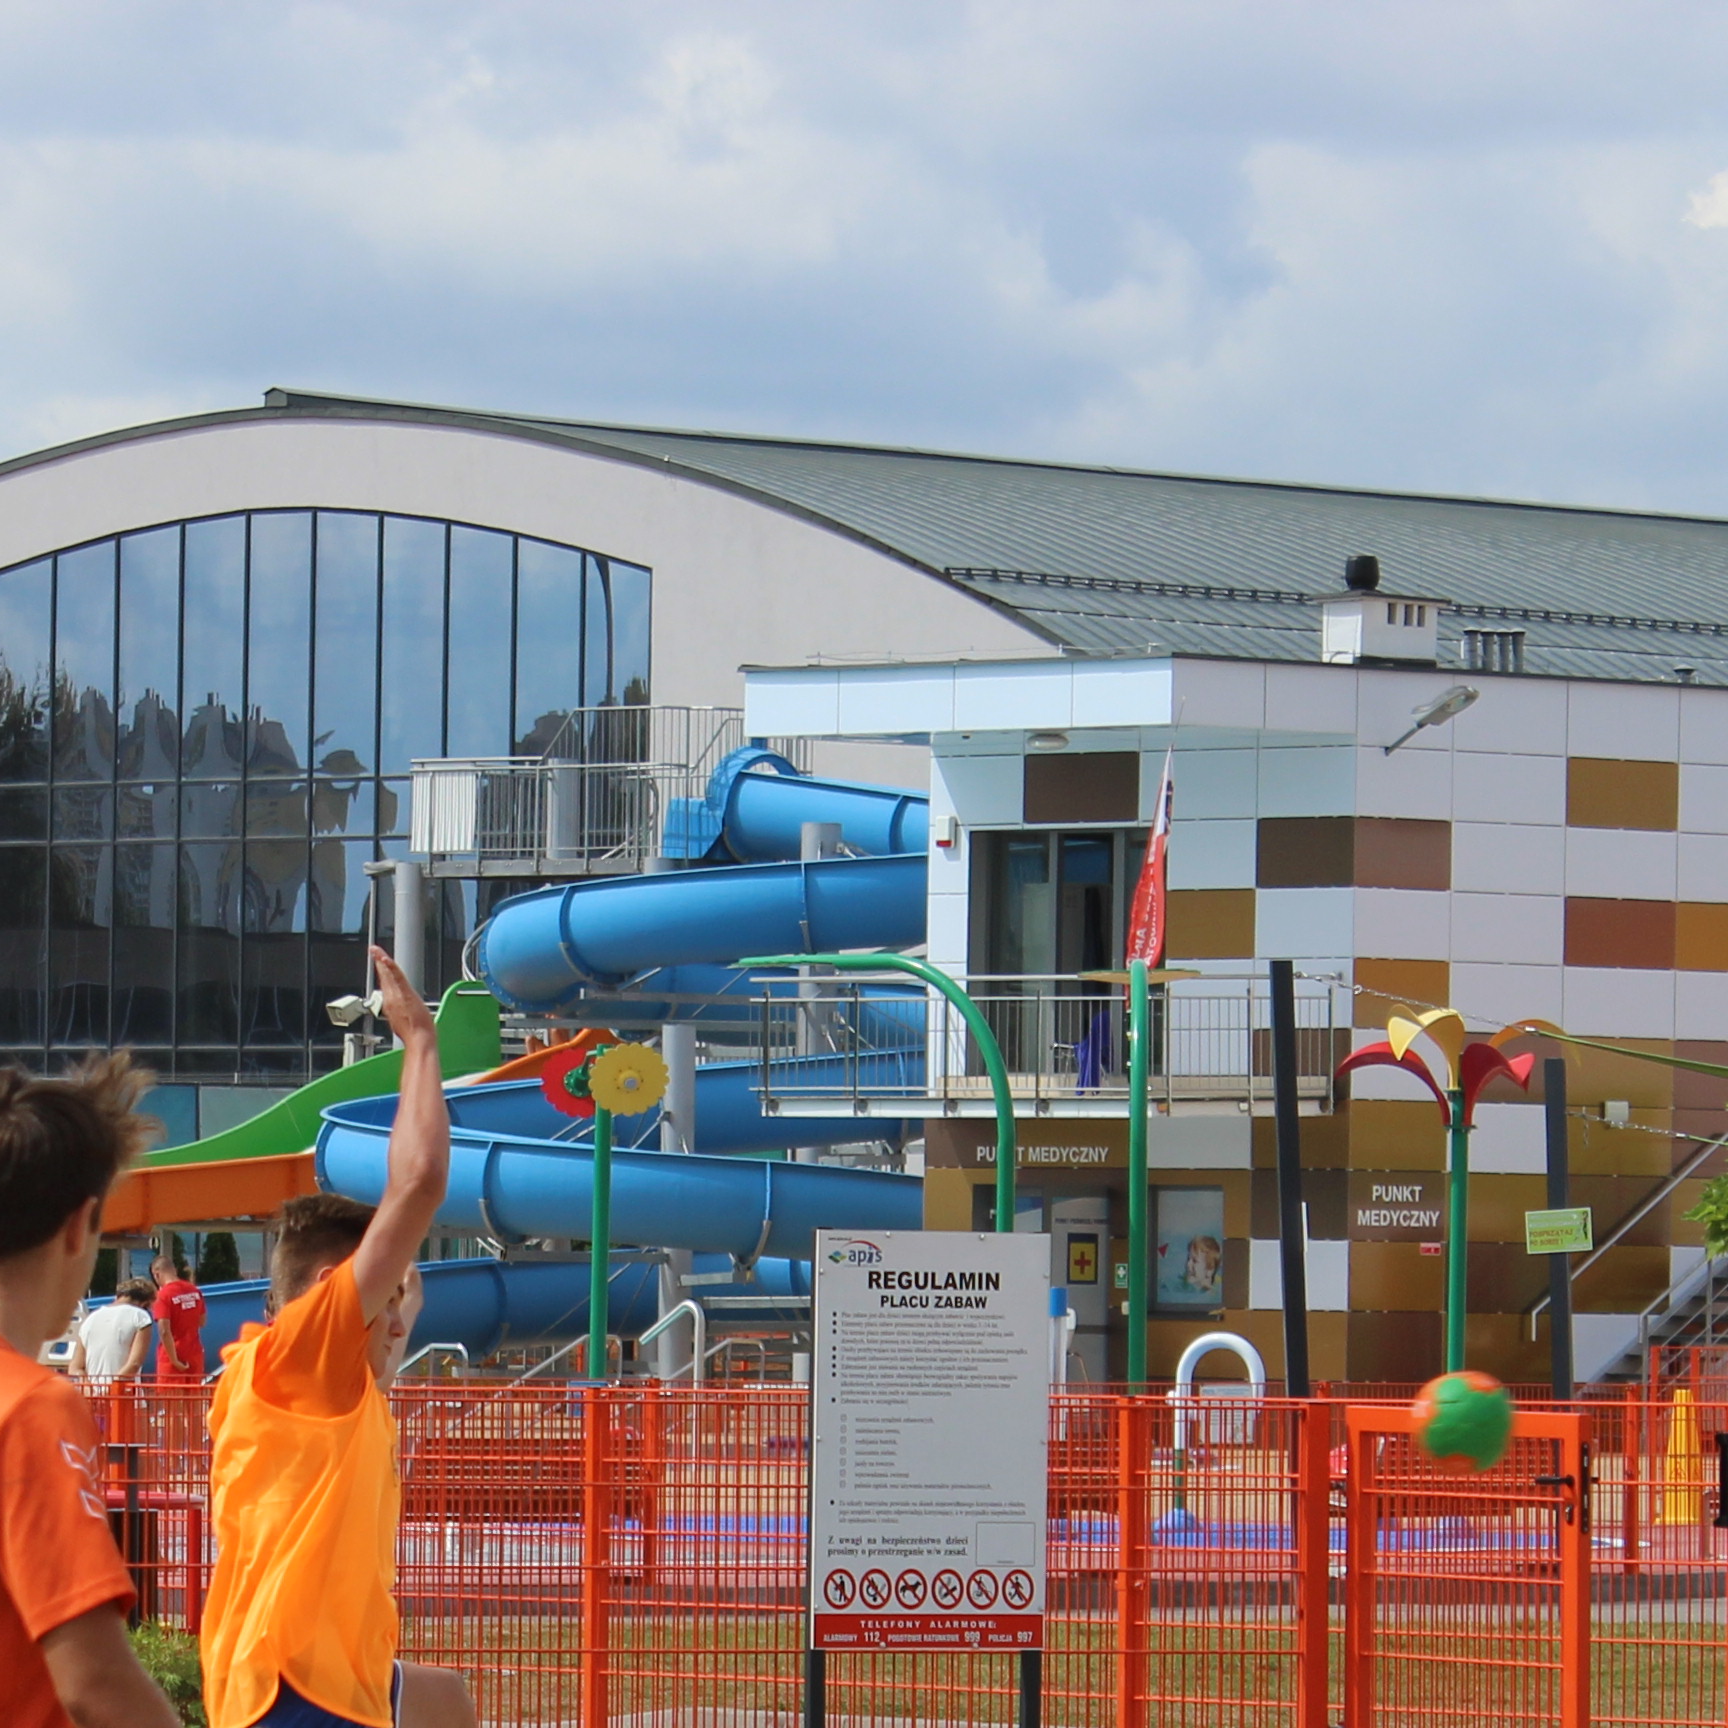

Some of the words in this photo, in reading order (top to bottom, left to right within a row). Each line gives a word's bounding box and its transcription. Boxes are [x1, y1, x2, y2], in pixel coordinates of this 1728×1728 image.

[977, 1146, 1025, 1161] PUT
[1028, 1147, 1109, 1162] MEDYCZNY
[1372, 1185, 1423, 1202] PUNKT
[1357, 1210, 1440, 1227] MEDYCZNY
[868, 1271, 1001, 1291] REGULAMIN
[880, 1296, 929, 1309] PLACU
[934, 1296, 988, 1309] ZABAW
[945, 1535, 968, 1545] dzieci
[860, 1620, 921, 1629] TELEFONY
[864, 1631, 880, 1642] 112
[964, 1631, 981, 1642] 999
[1017, 1631, 1033, 1642] 997
